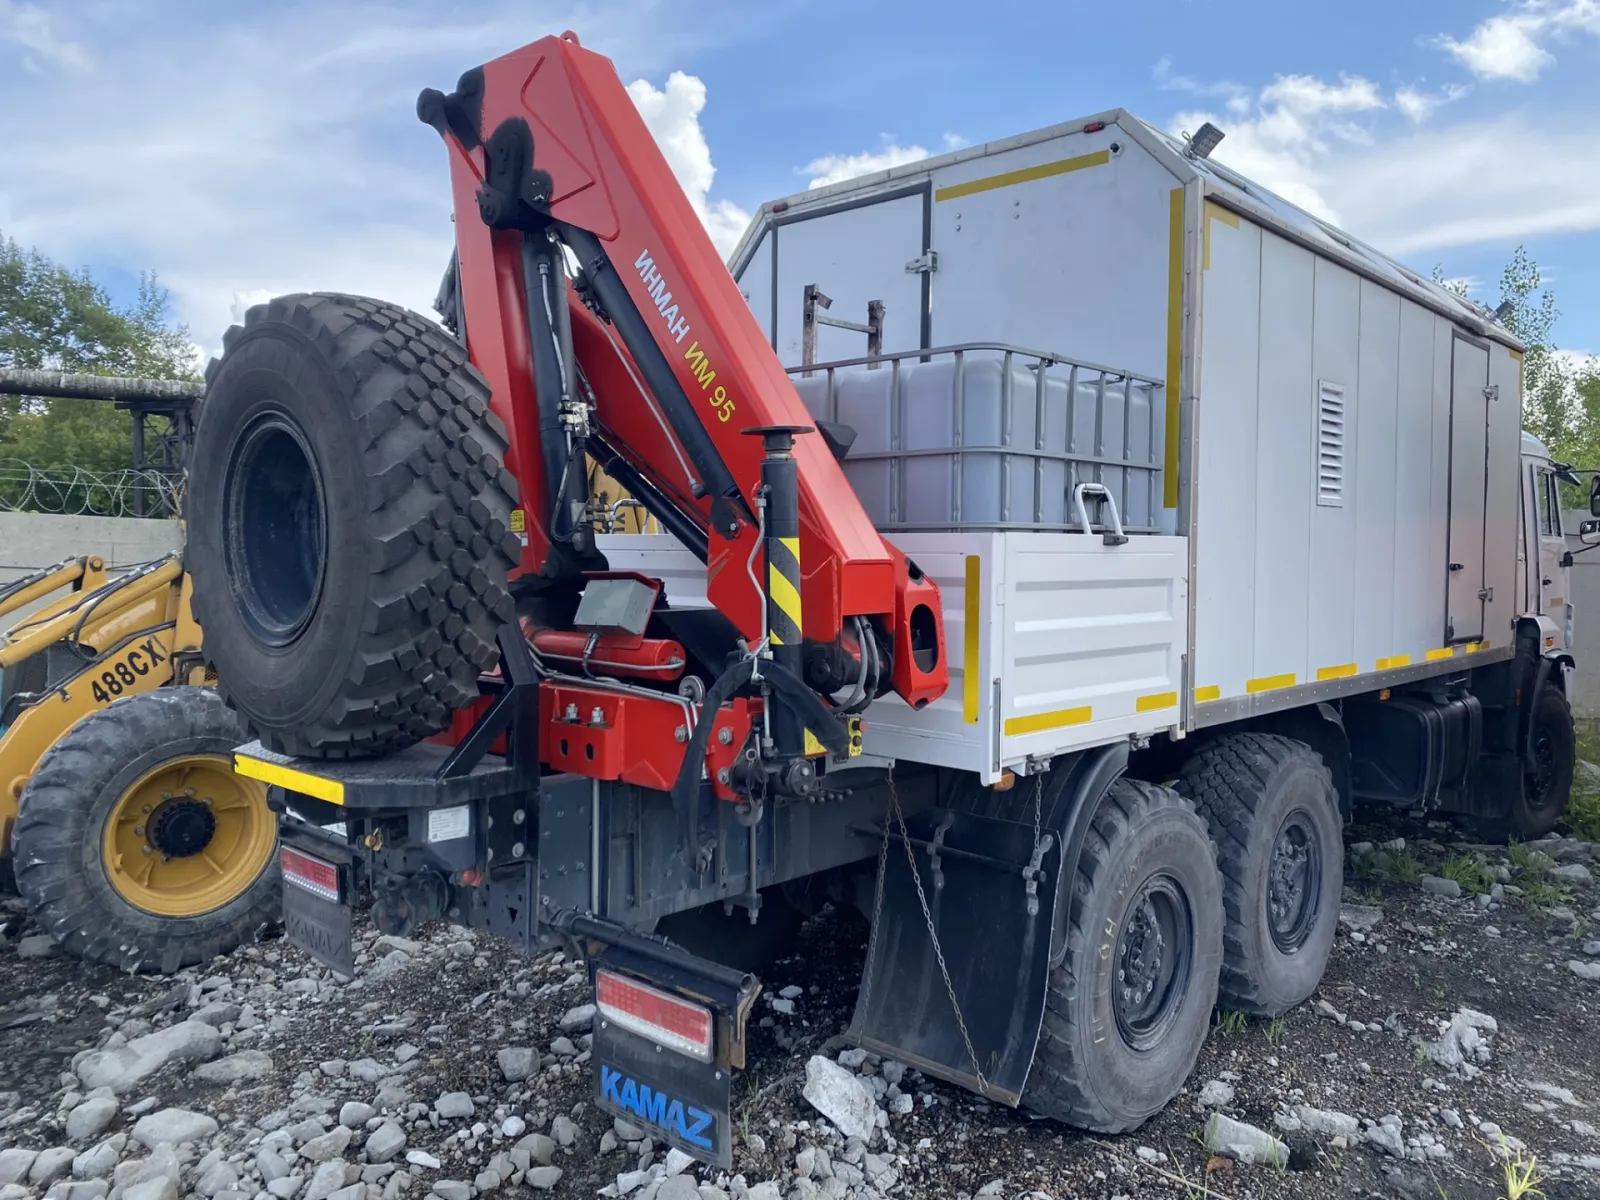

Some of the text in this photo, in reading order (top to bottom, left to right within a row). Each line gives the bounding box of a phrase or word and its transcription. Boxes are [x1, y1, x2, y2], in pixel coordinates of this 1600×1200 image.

[634, 249, 736, 422] ИНМАН ИМ 95
[91, 638, 165, 702] 488CX
[602, 1065, 712, 1148] KAMAZ
